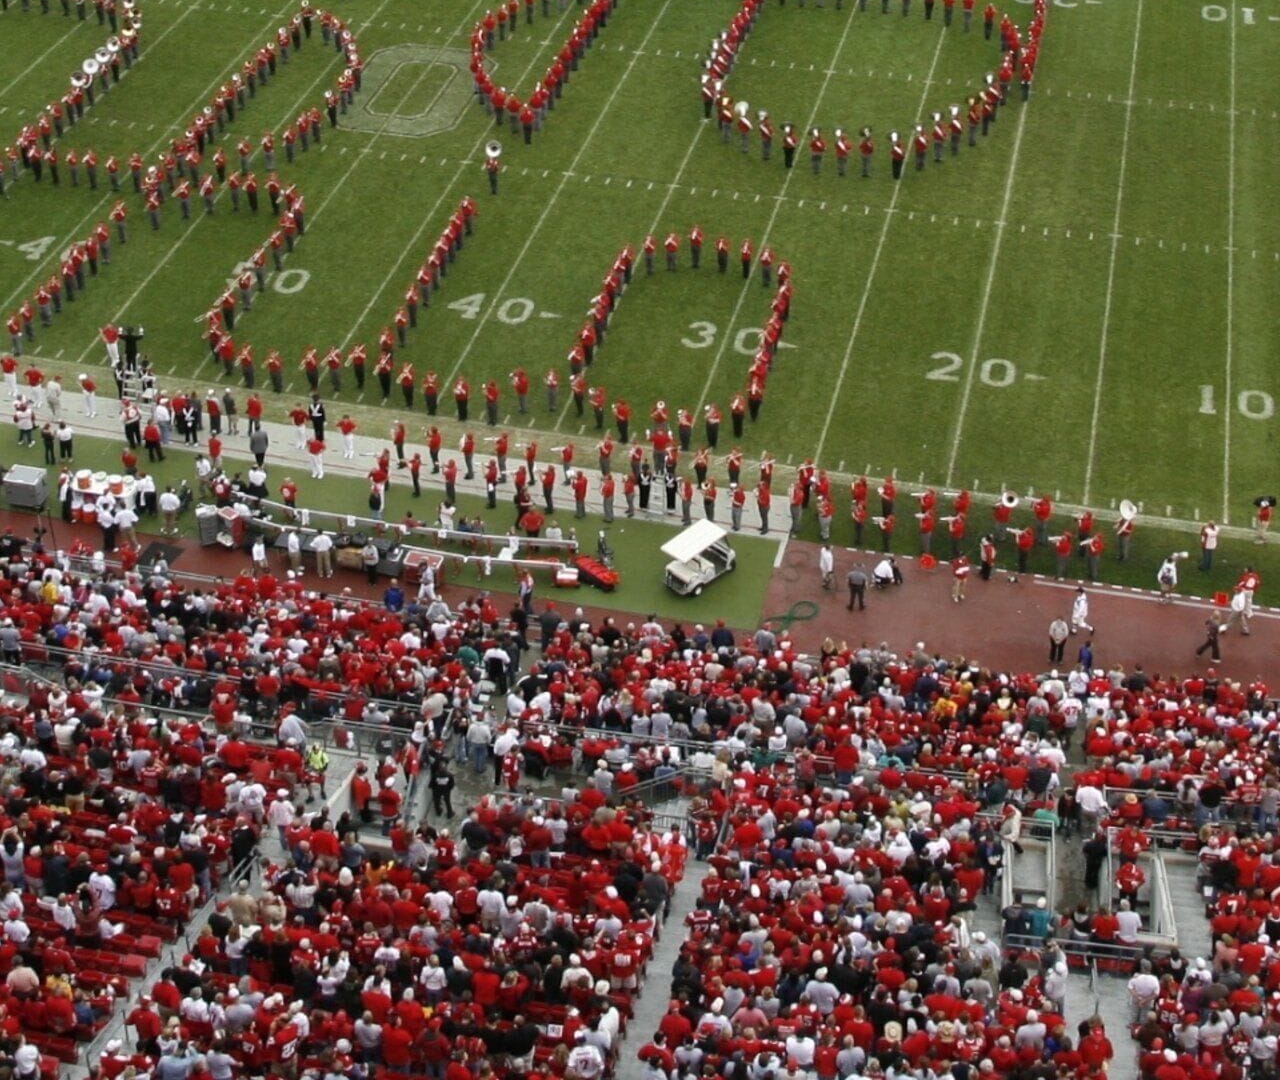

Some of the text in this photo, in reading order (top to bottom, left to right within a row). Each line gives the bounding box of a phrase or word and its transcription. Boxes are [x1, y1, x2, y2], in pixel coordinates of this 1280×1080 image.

[447, 292, 535, 324] 40
[681, 321, 766, 355] 30
[926, 351, 1017, 387] 20
[1198, 384, 1275, 420] 10
